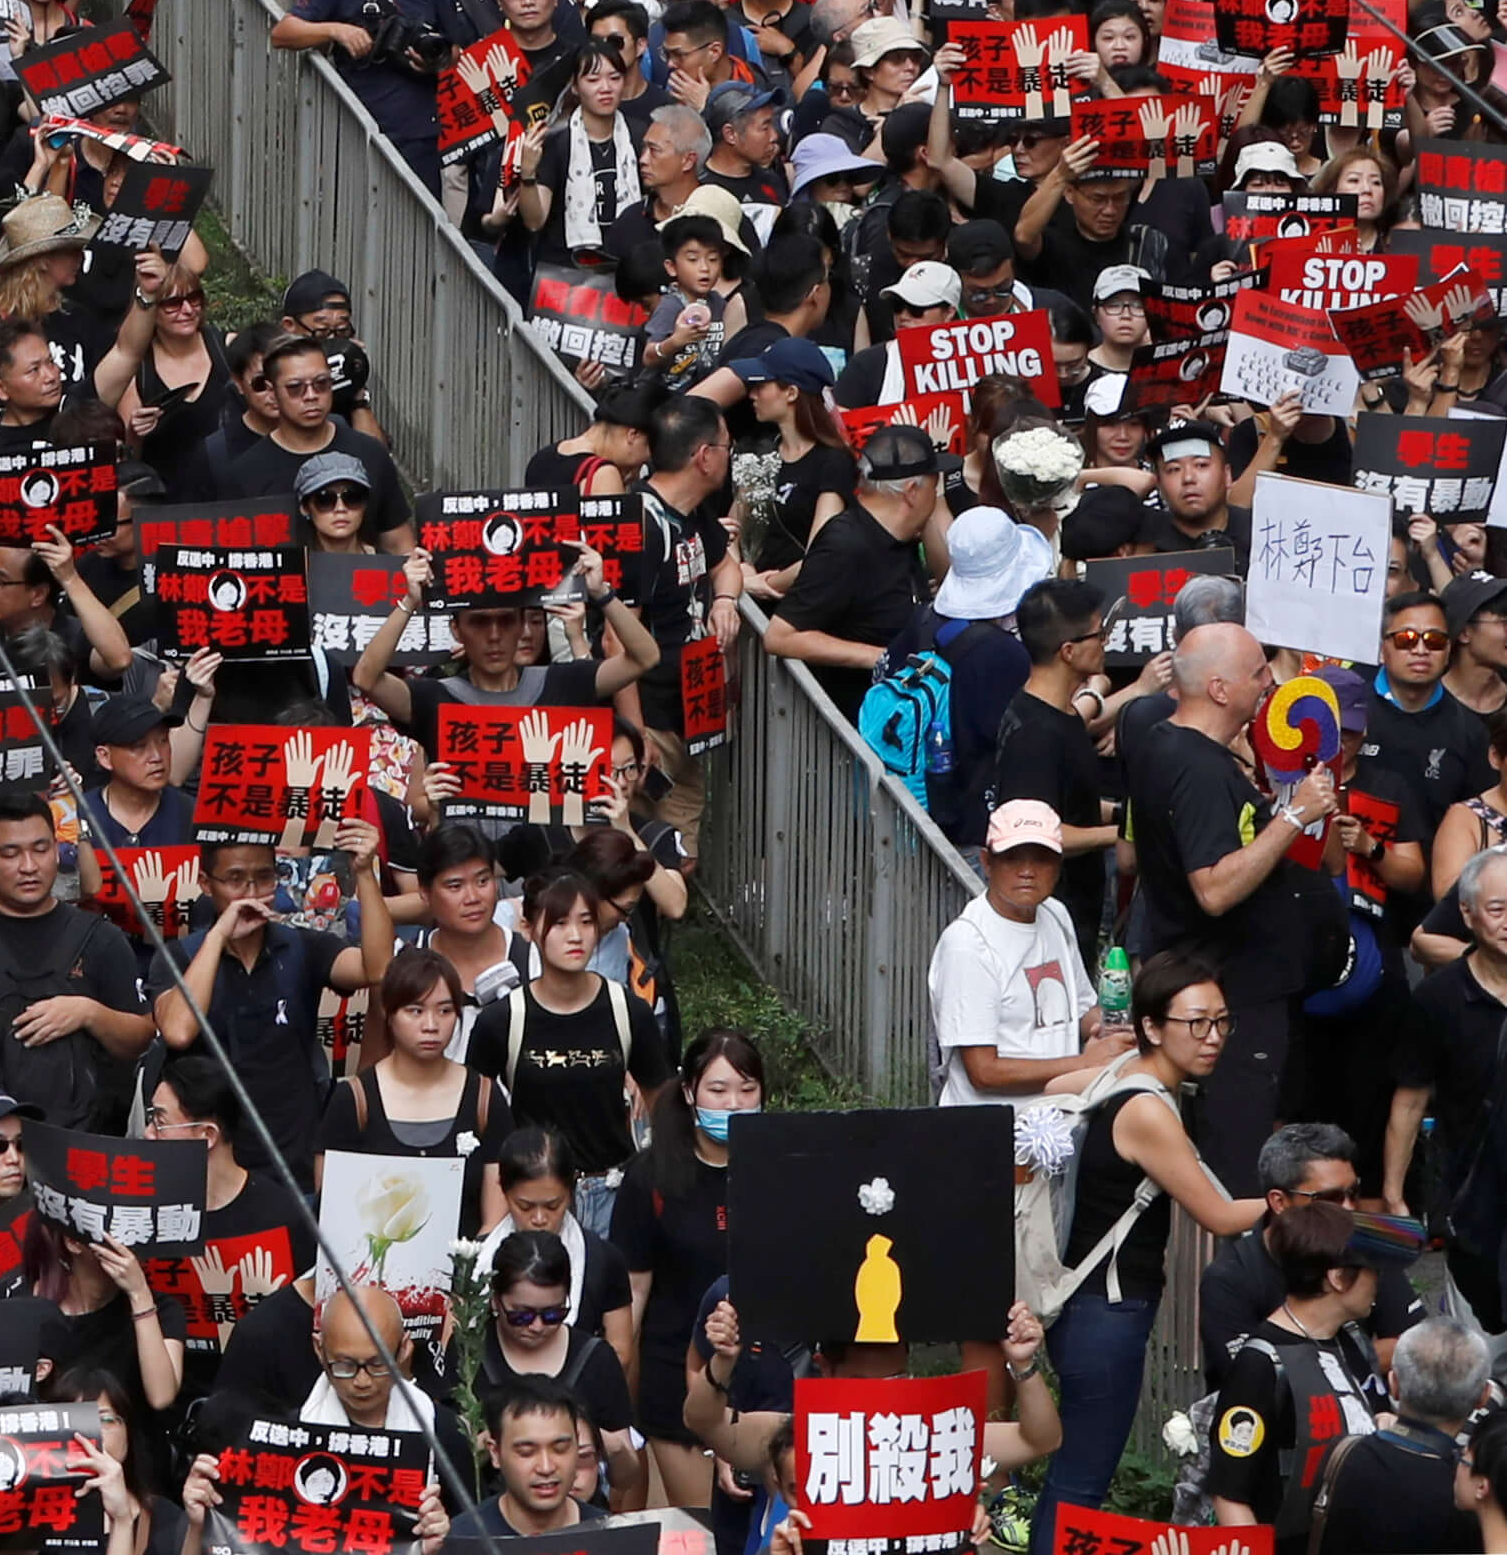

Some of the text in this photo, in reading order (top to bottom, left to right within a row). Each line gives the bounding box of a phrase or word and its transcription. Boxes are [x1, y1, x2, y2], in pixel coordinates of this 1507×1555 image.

[1302, 257, 1387, 291] STOP
[930, 320, 1016, 361] STOP
[913, 347, 1044, 394] KILLING
[1395, 430, 1471, 468] 學生
[443, 550, 563, 595] 我老母
[175, 609, 290, 647] 我老母
[445, 720, 516, 754] 孩子
[208, 740, 280, 779] 孩子
[202, 782, 364, 821] 不是暴徒！
[65, 1148, 156, 1197] 學生
[806, 1405, 976, 1509] 別殺我
